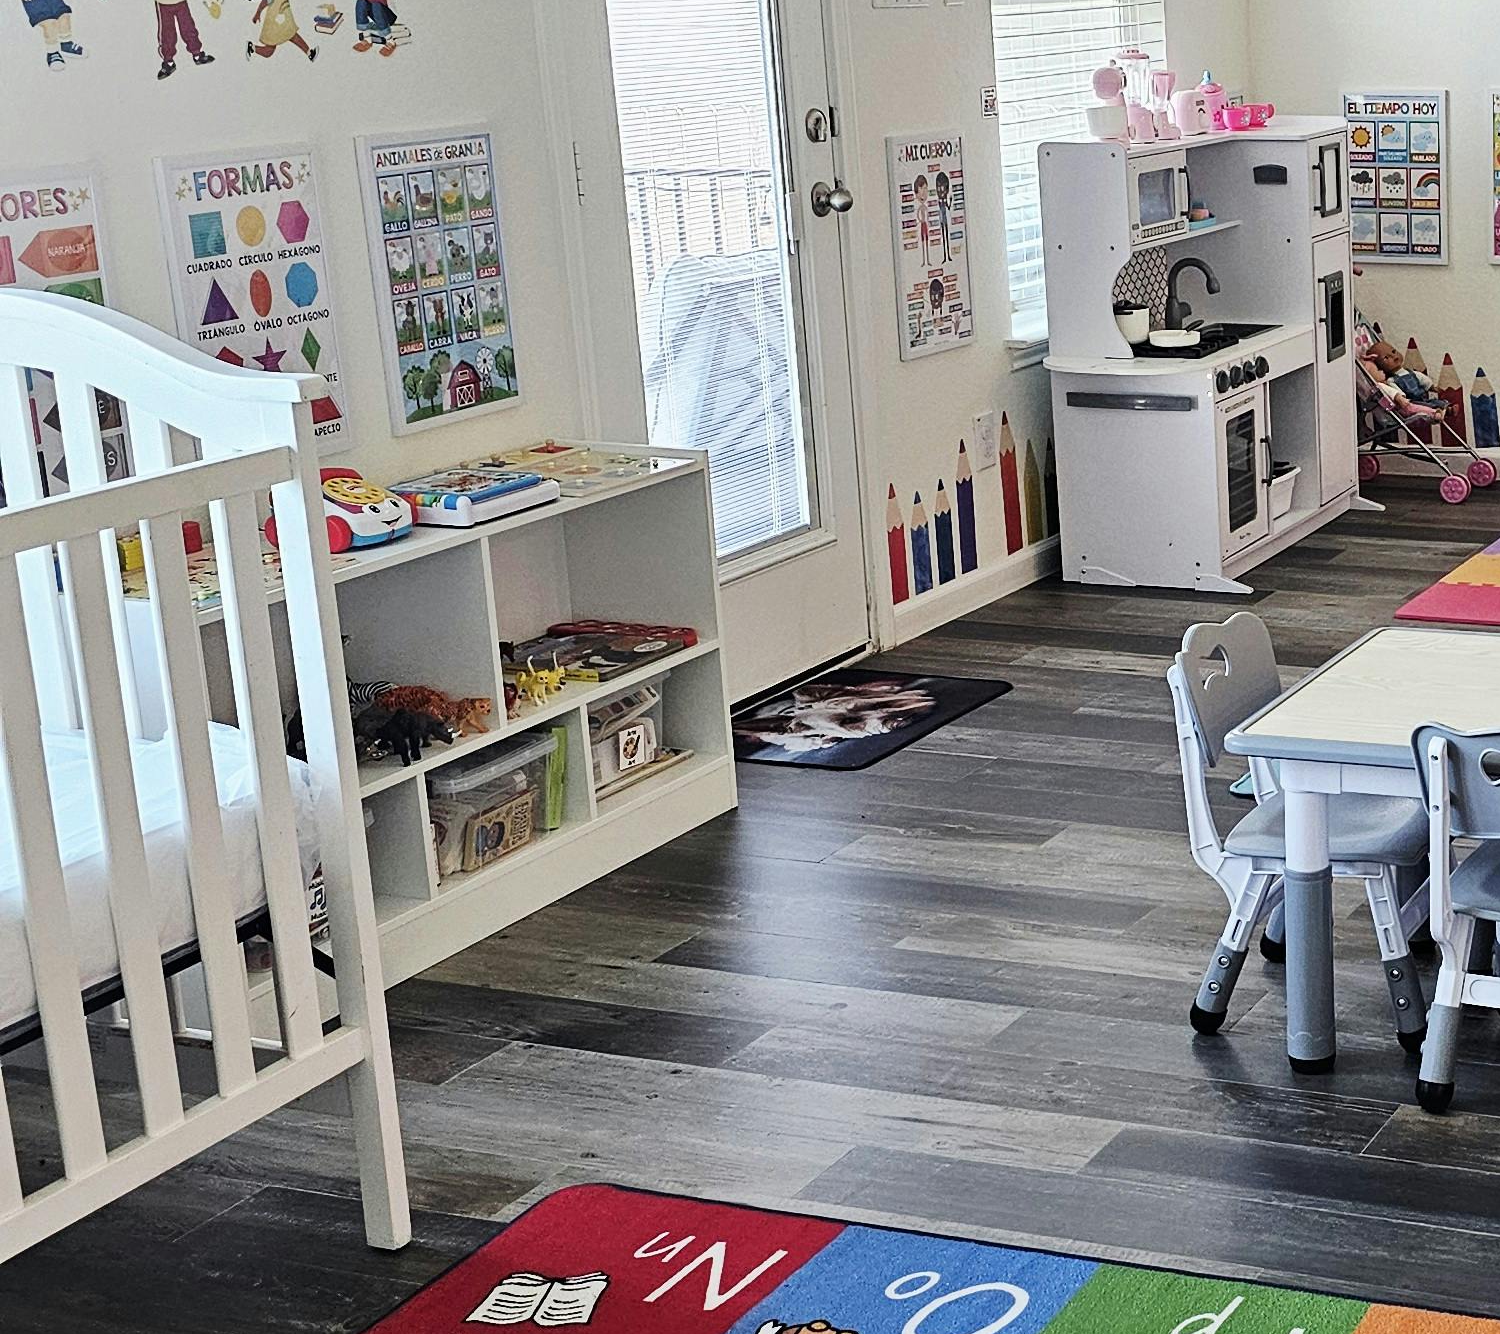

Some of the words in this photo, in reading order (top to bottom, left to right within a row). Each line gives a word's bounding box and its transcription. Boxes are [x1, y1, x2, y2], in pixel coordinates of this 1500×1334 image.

[1347, 102, 1360, 114] EL
[1363, 103, 1409, 114] TIEMPO
[1412, 102, 1436, 115] HOY
[376, 148, 432, 168] ANIMALES
[445, 142, 485, 159] GRANJA
[905, 145, 919, 162] MI
[920, 141, 952, 160] CUERPO
[193, 161, 293, 201] FORMAS
[0, 187, 68, 222] ORES
[385, 222, 407, 232] GALLO
[186, 259, 232, 274] CUADRADO
[393, 283, 416, 294] OVEJA
[429, 336, 452, 348] CABRA
[460, 331, 478, 341] VACA
[315, 423, 340, 436] APECIO
